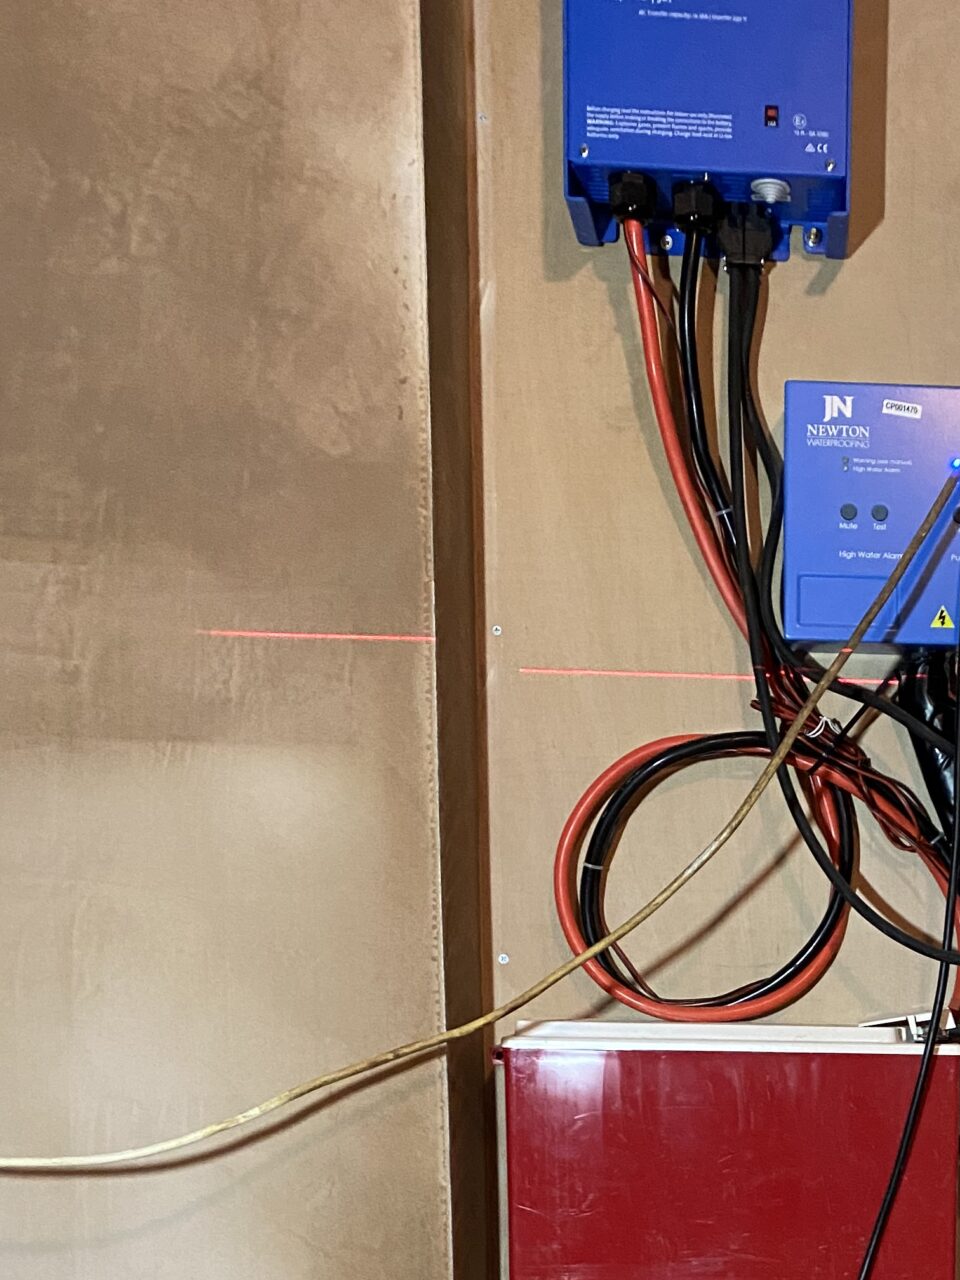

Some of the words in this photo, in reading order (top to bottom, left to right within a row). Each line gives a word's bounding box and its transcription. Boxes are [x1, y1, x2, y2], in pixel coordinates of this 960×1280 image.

[806, 424, 870, 438] NEWTON
[806, 438, 870, 449] WATERPROOFING
[839, 522, 858, 530] Mute
[873, 523, 887, 531] Test
[839, 550, 856, 560] High
[857, 551, 882, 560] Water
